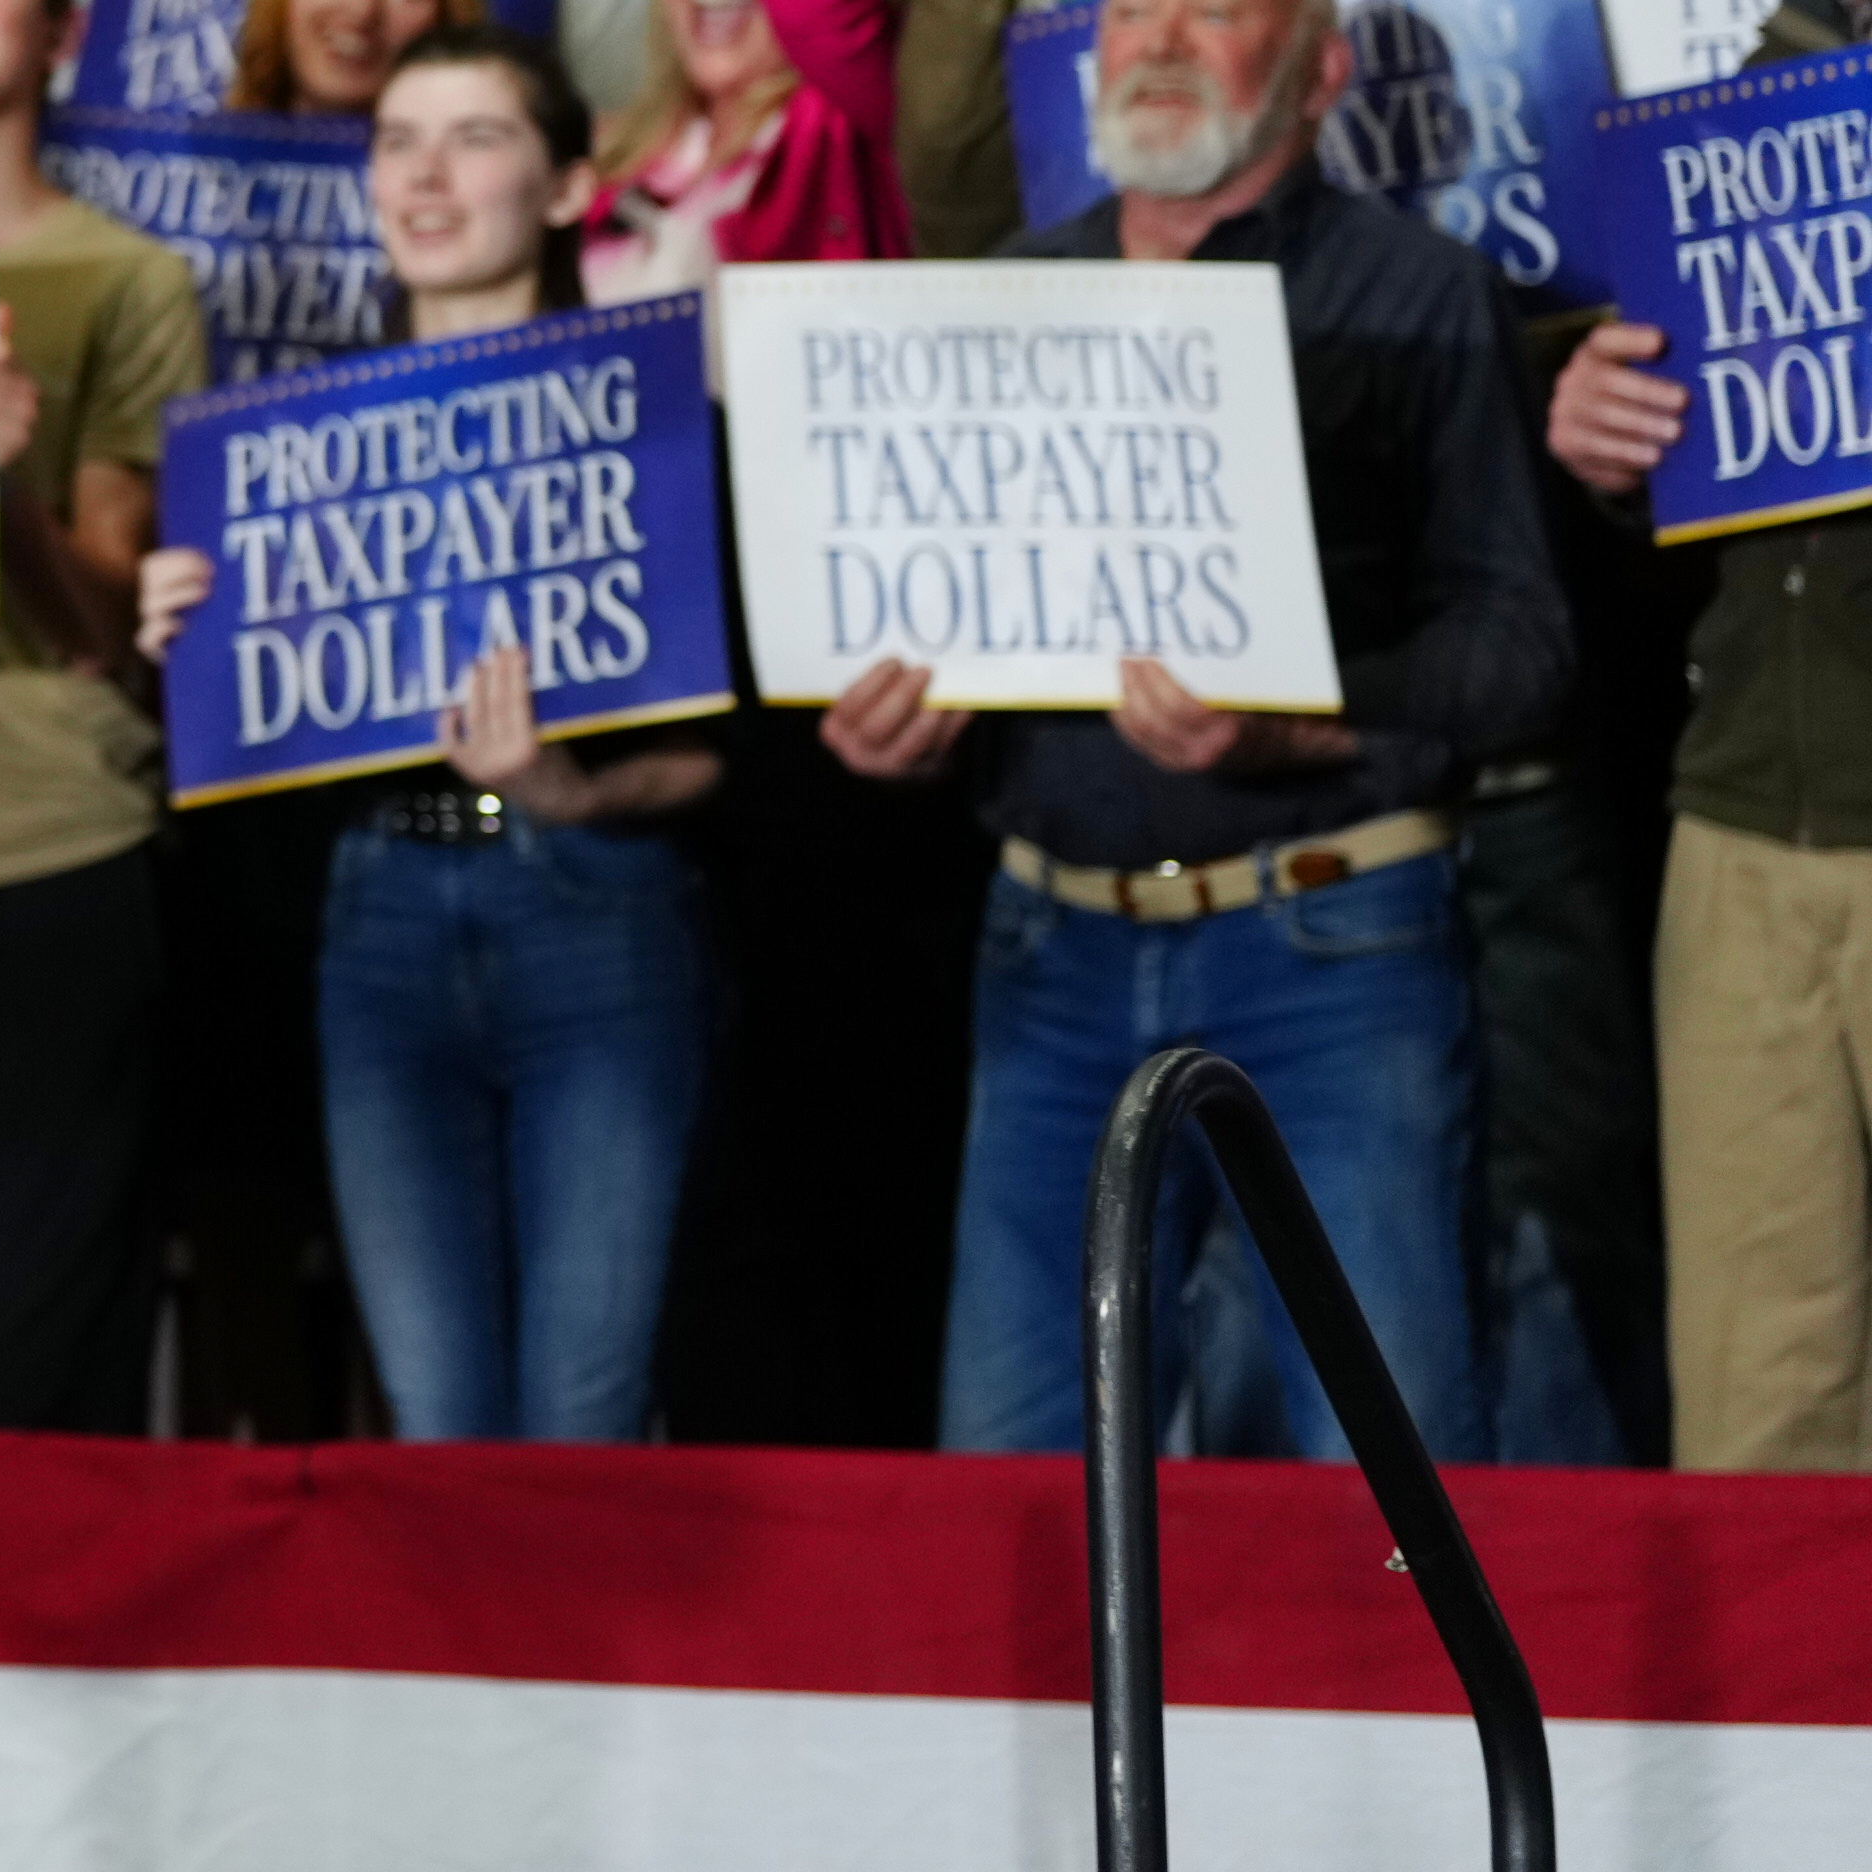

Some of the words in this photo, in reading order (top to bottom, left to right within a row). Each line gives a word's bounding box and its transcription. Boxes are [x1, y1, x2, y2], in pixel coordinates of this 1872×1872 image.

[224, 355, 639, 519] PROTECTING
[799, 326, 1220, 415] PROTECTING
[222, 450, 647, 626] TAXPAYER
[807, 421, 1239, 532] TAXPAYER
[233, 559, 651, 748] DOLLARS
[823, 539, 1253, 660] DOLLARS
